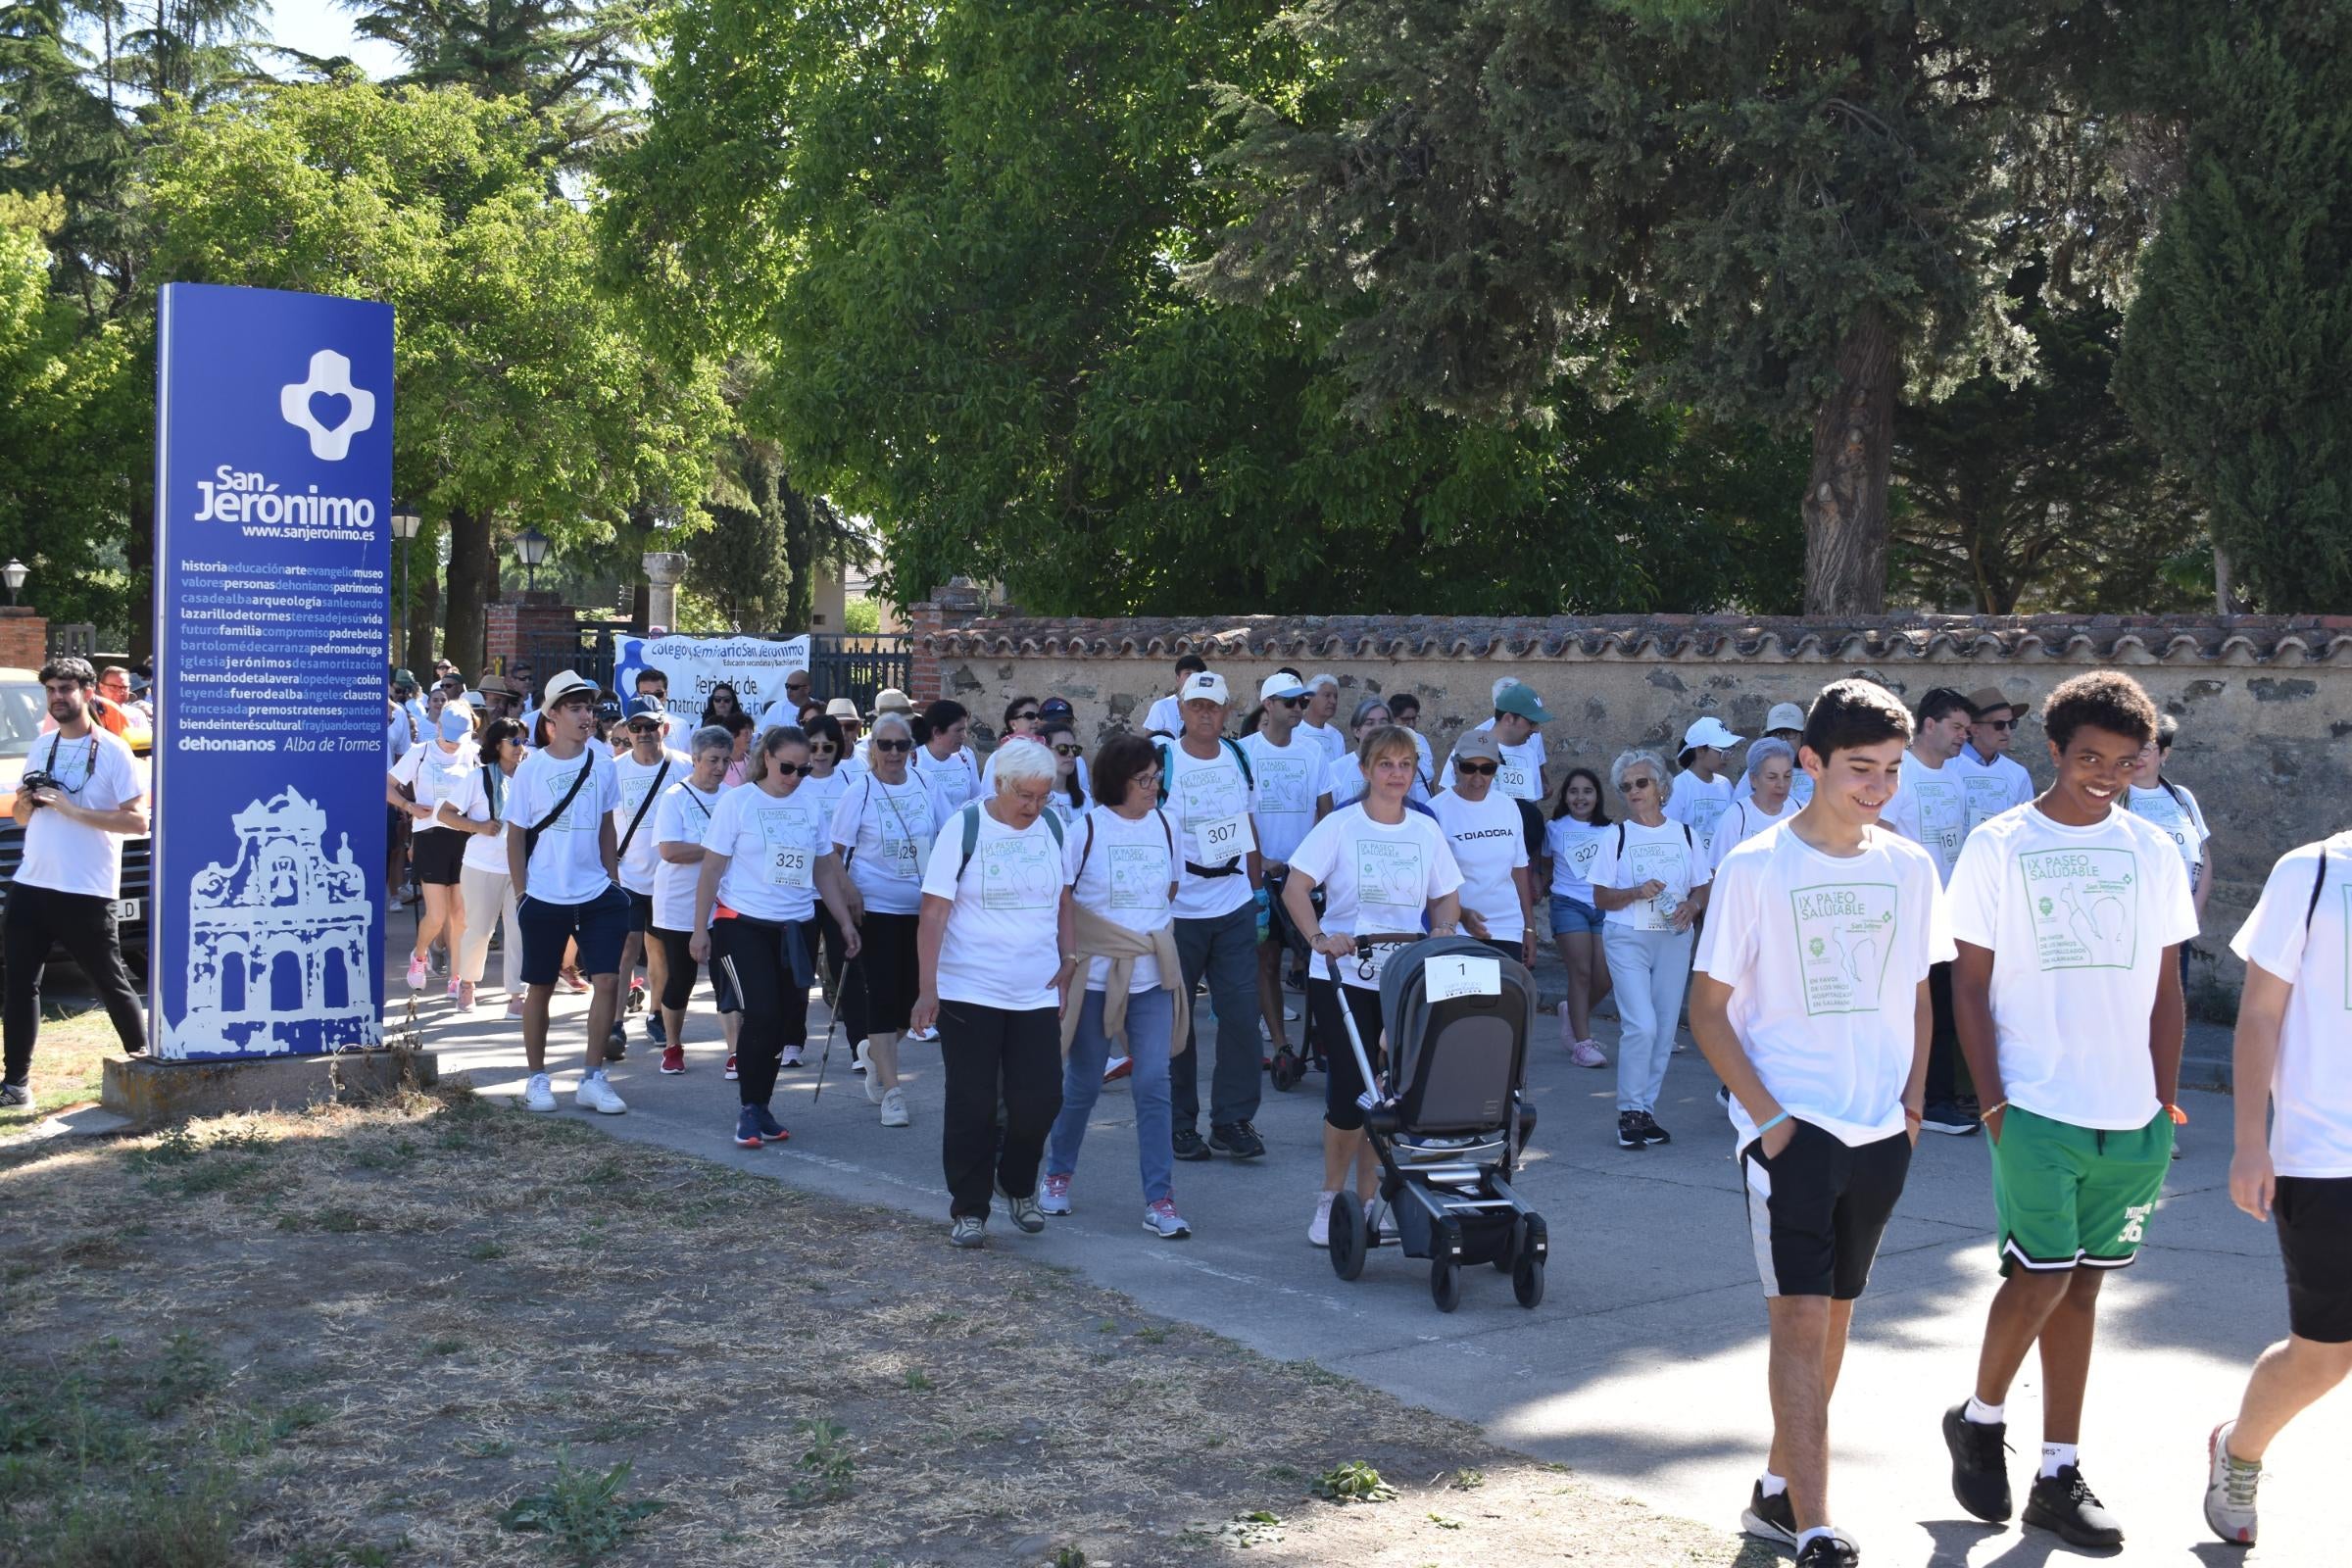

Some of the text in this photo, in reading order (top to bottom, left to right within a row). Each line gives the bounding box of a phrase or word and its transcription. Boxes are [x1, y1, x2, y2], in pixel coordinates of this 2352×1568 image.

[216, 465, 264, 492] San
[194, 480, 375, 528] Jerónimo
[242, 525, 375, 541] www.sanjeronimo.es
[742, 643, 757, 658] San
[743, 675, 758, 695] de
[283, 737, 316, 752] Alba
[318, 737, 334, 752] de
[338, 737, 381, 752] Tormes
[1503, 772, 1524, 785] 320
[1207, 823, 1237, 845] 307
[1464, 829, 1514, 840] DIADORA
[1940, 833, 1957, 849] 161
[775, 853, 804, 869] 325
[2028, 855, 2089, 870] IX PASEO
[2030, 866, 2100, 881] SALUDABLE
[1457, 963, 1465, 976] 1
